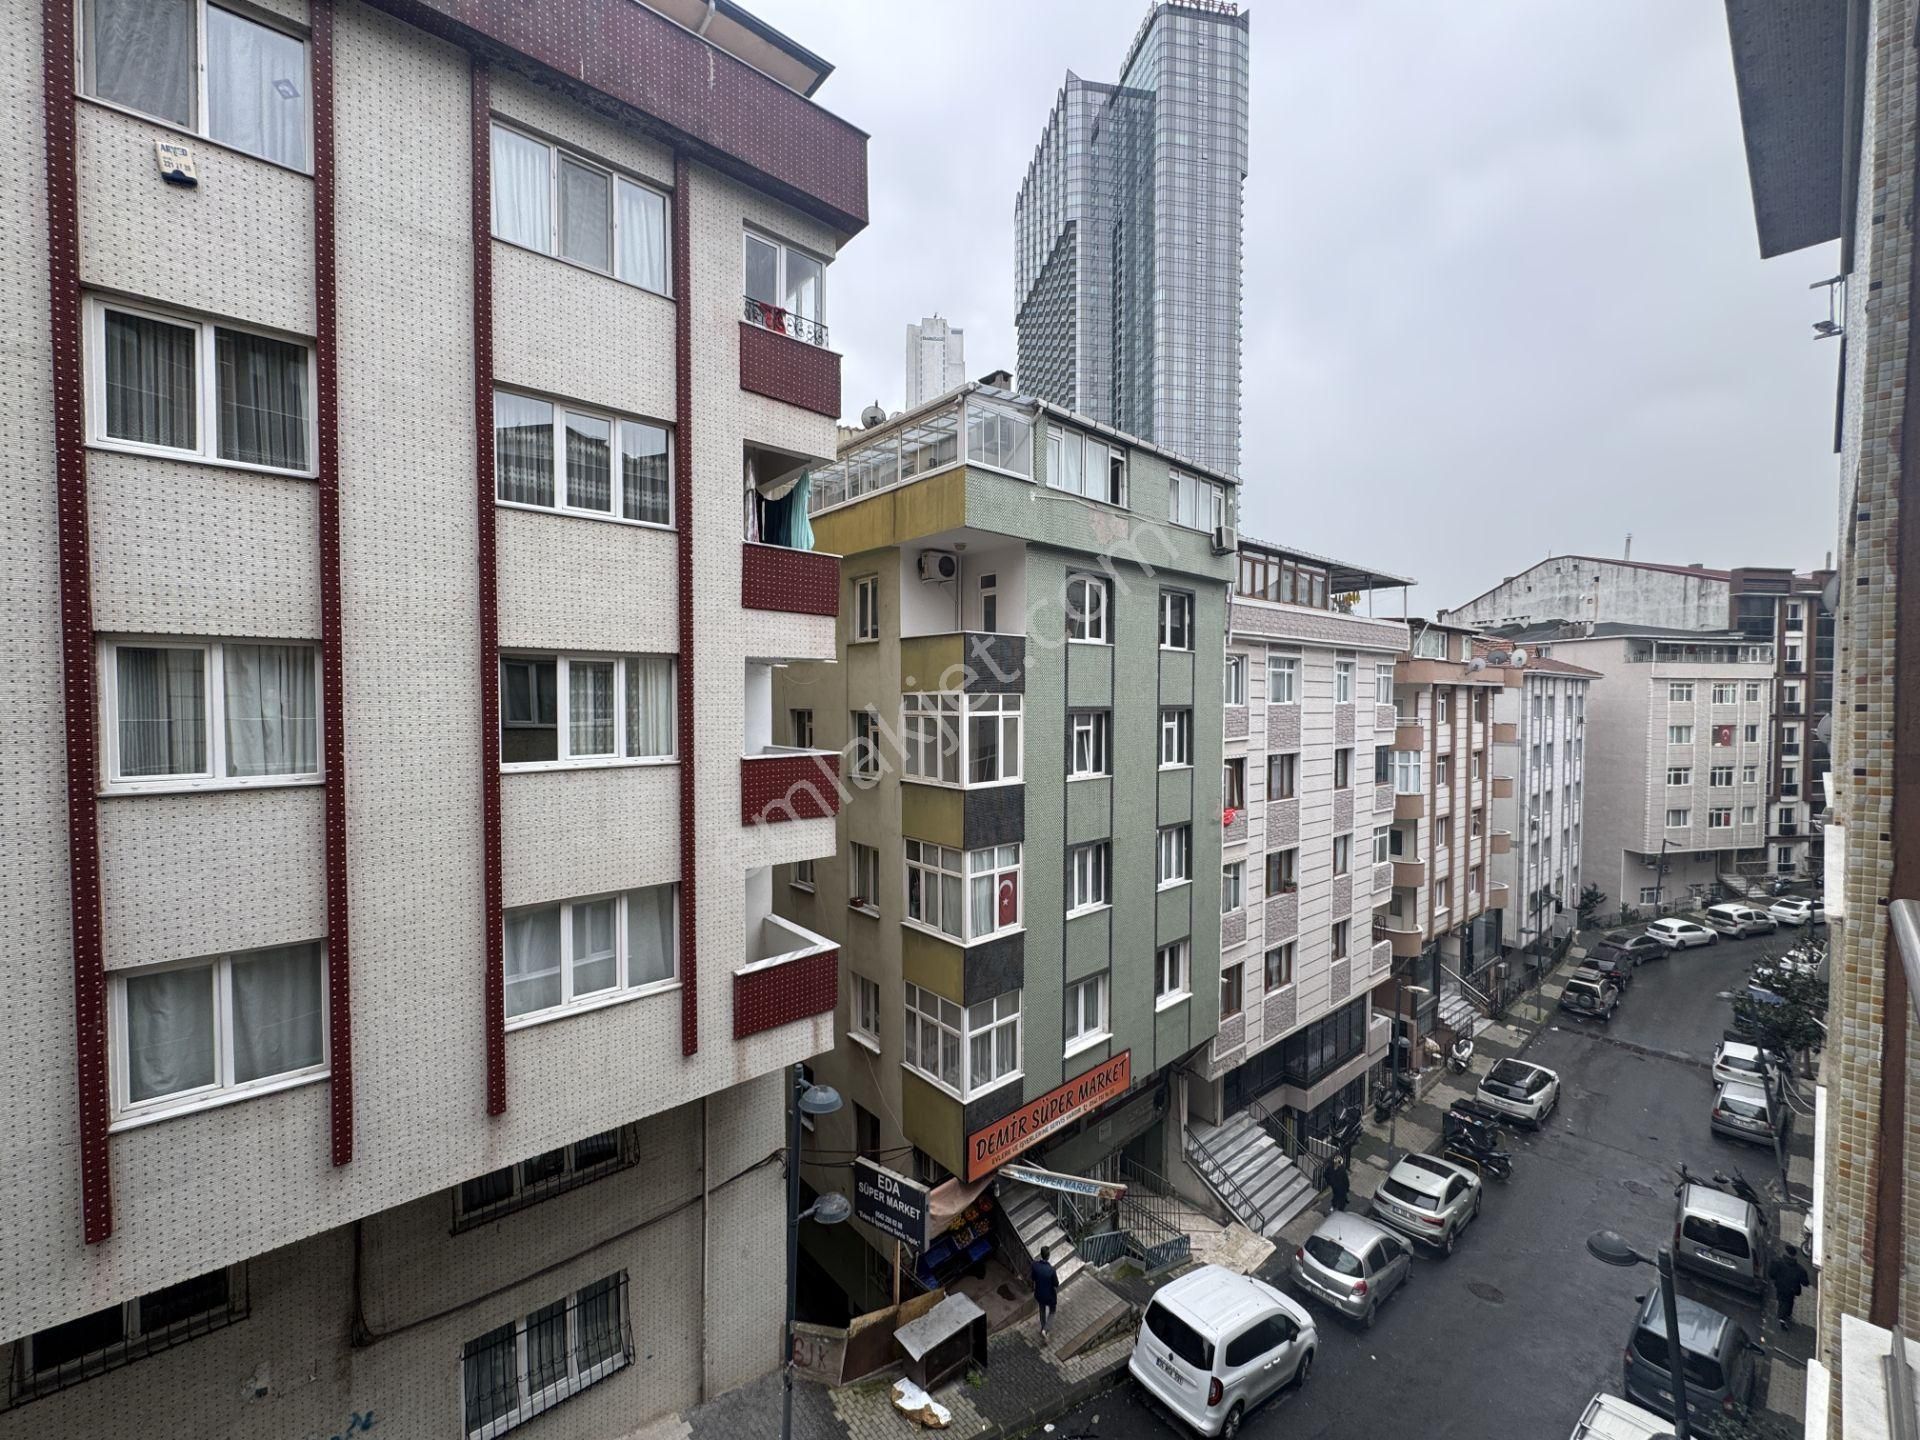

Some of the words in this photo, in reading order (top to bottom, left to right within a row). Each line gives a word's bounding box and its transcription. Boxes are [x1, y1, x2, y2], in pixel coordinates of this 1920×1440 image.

[976, 1115, 1027, 1161] DEMİR
[1032, 1090, 1074, 1129] SÜPER
[1078, 1059, 1127, 1104] MARKET
[877, 1174, 901, 1198] EDA
[1064, 1179, 1099, 1194] MARKET
[886, 1195, 921, 1220] MARKET
